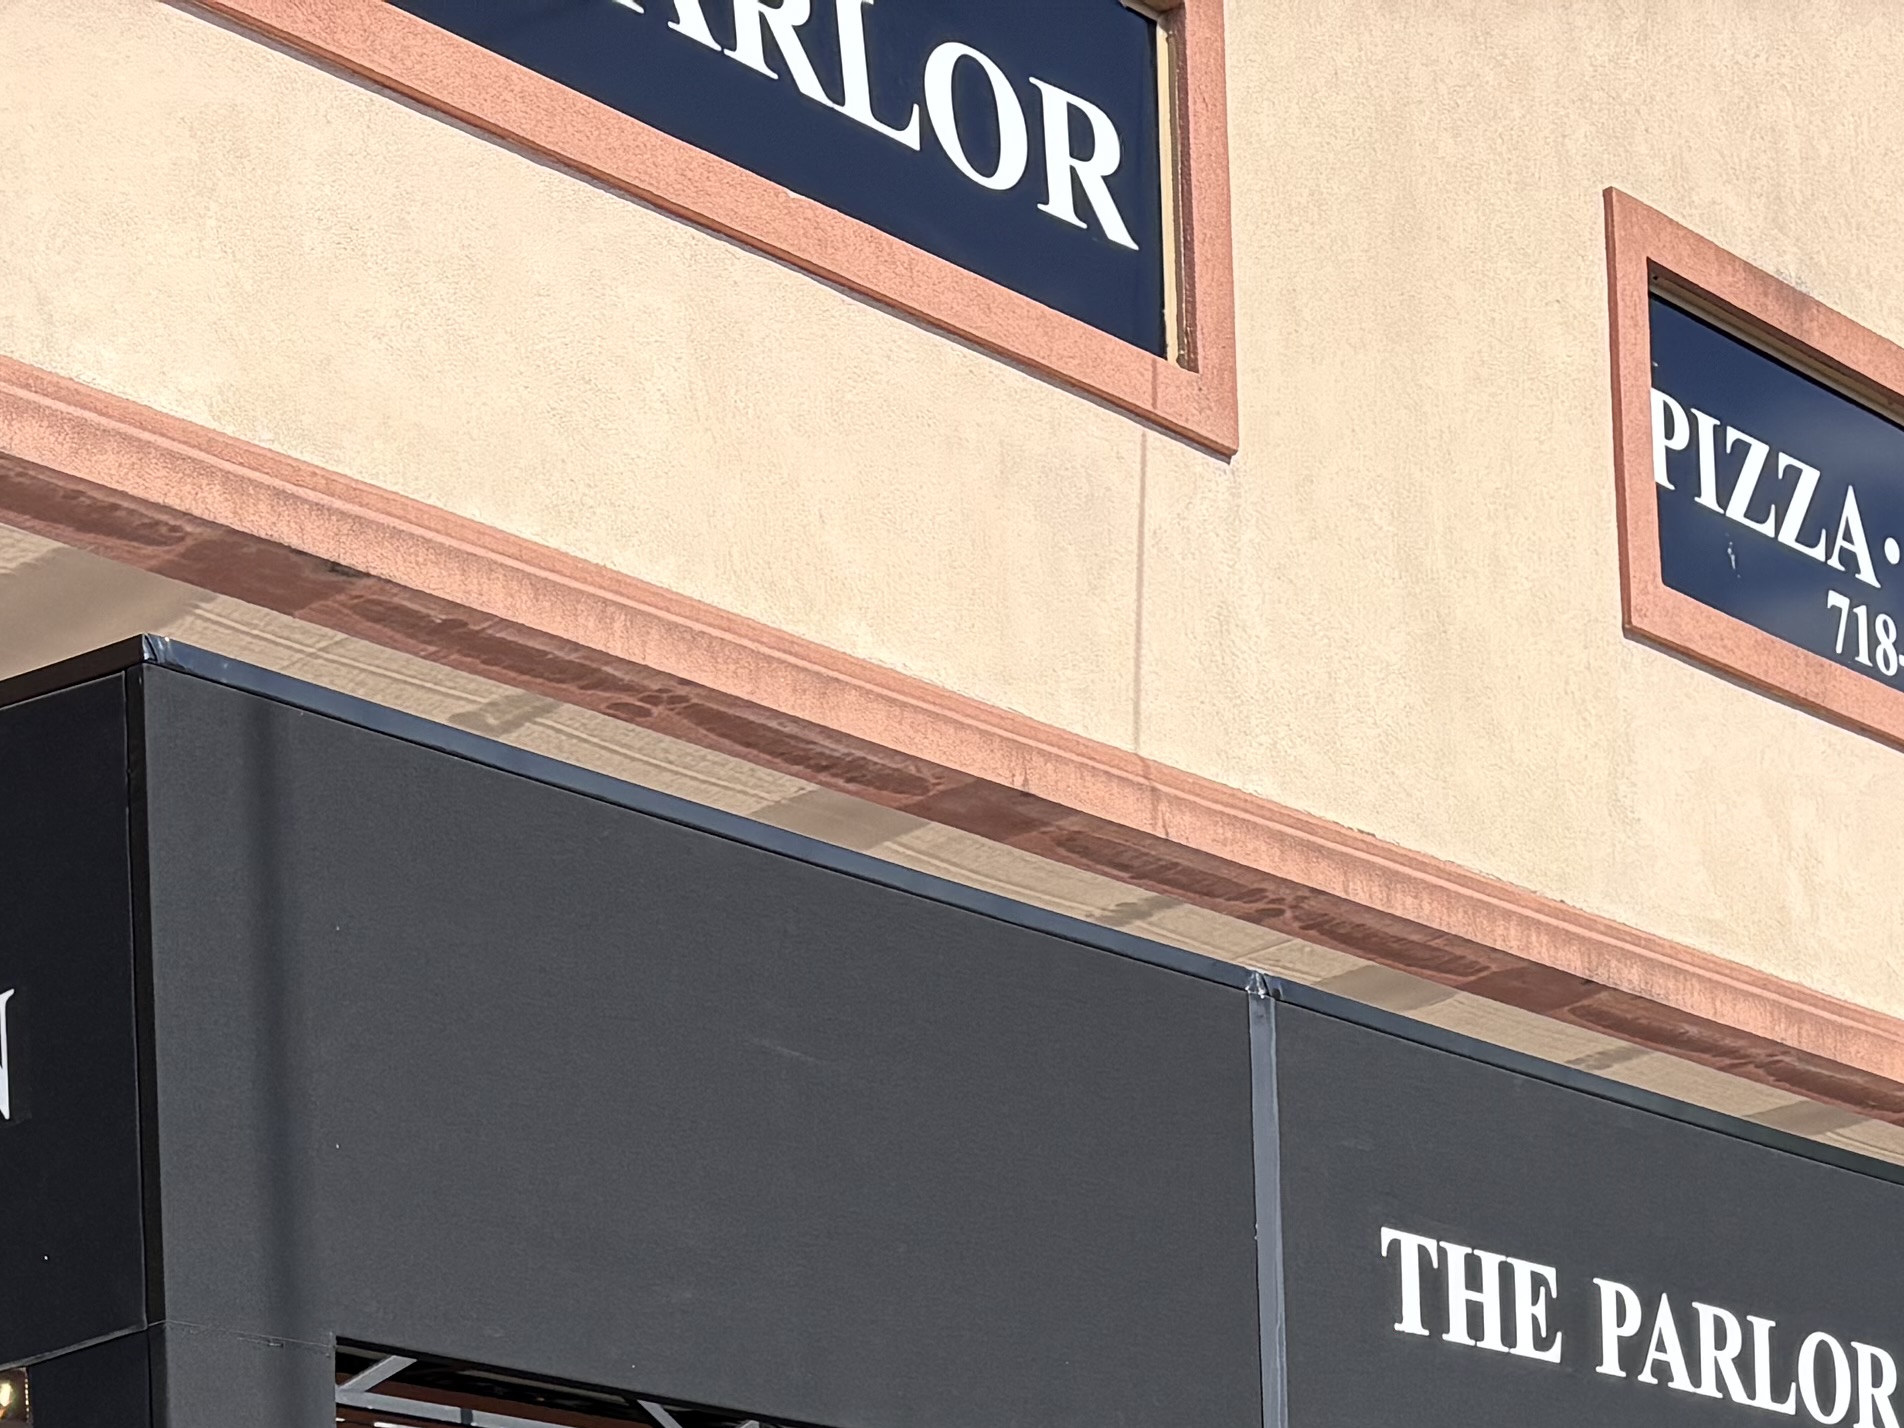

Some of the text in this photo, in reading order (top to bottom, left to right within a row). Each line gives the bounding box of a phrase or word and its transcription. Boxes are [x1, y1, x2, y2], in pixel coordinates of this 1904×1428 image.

[613, 0, 1139, 251] RLOR
[1651, 387, 1882, 588] PIZZA
[1380, 1226, 1563, 1364] THE
